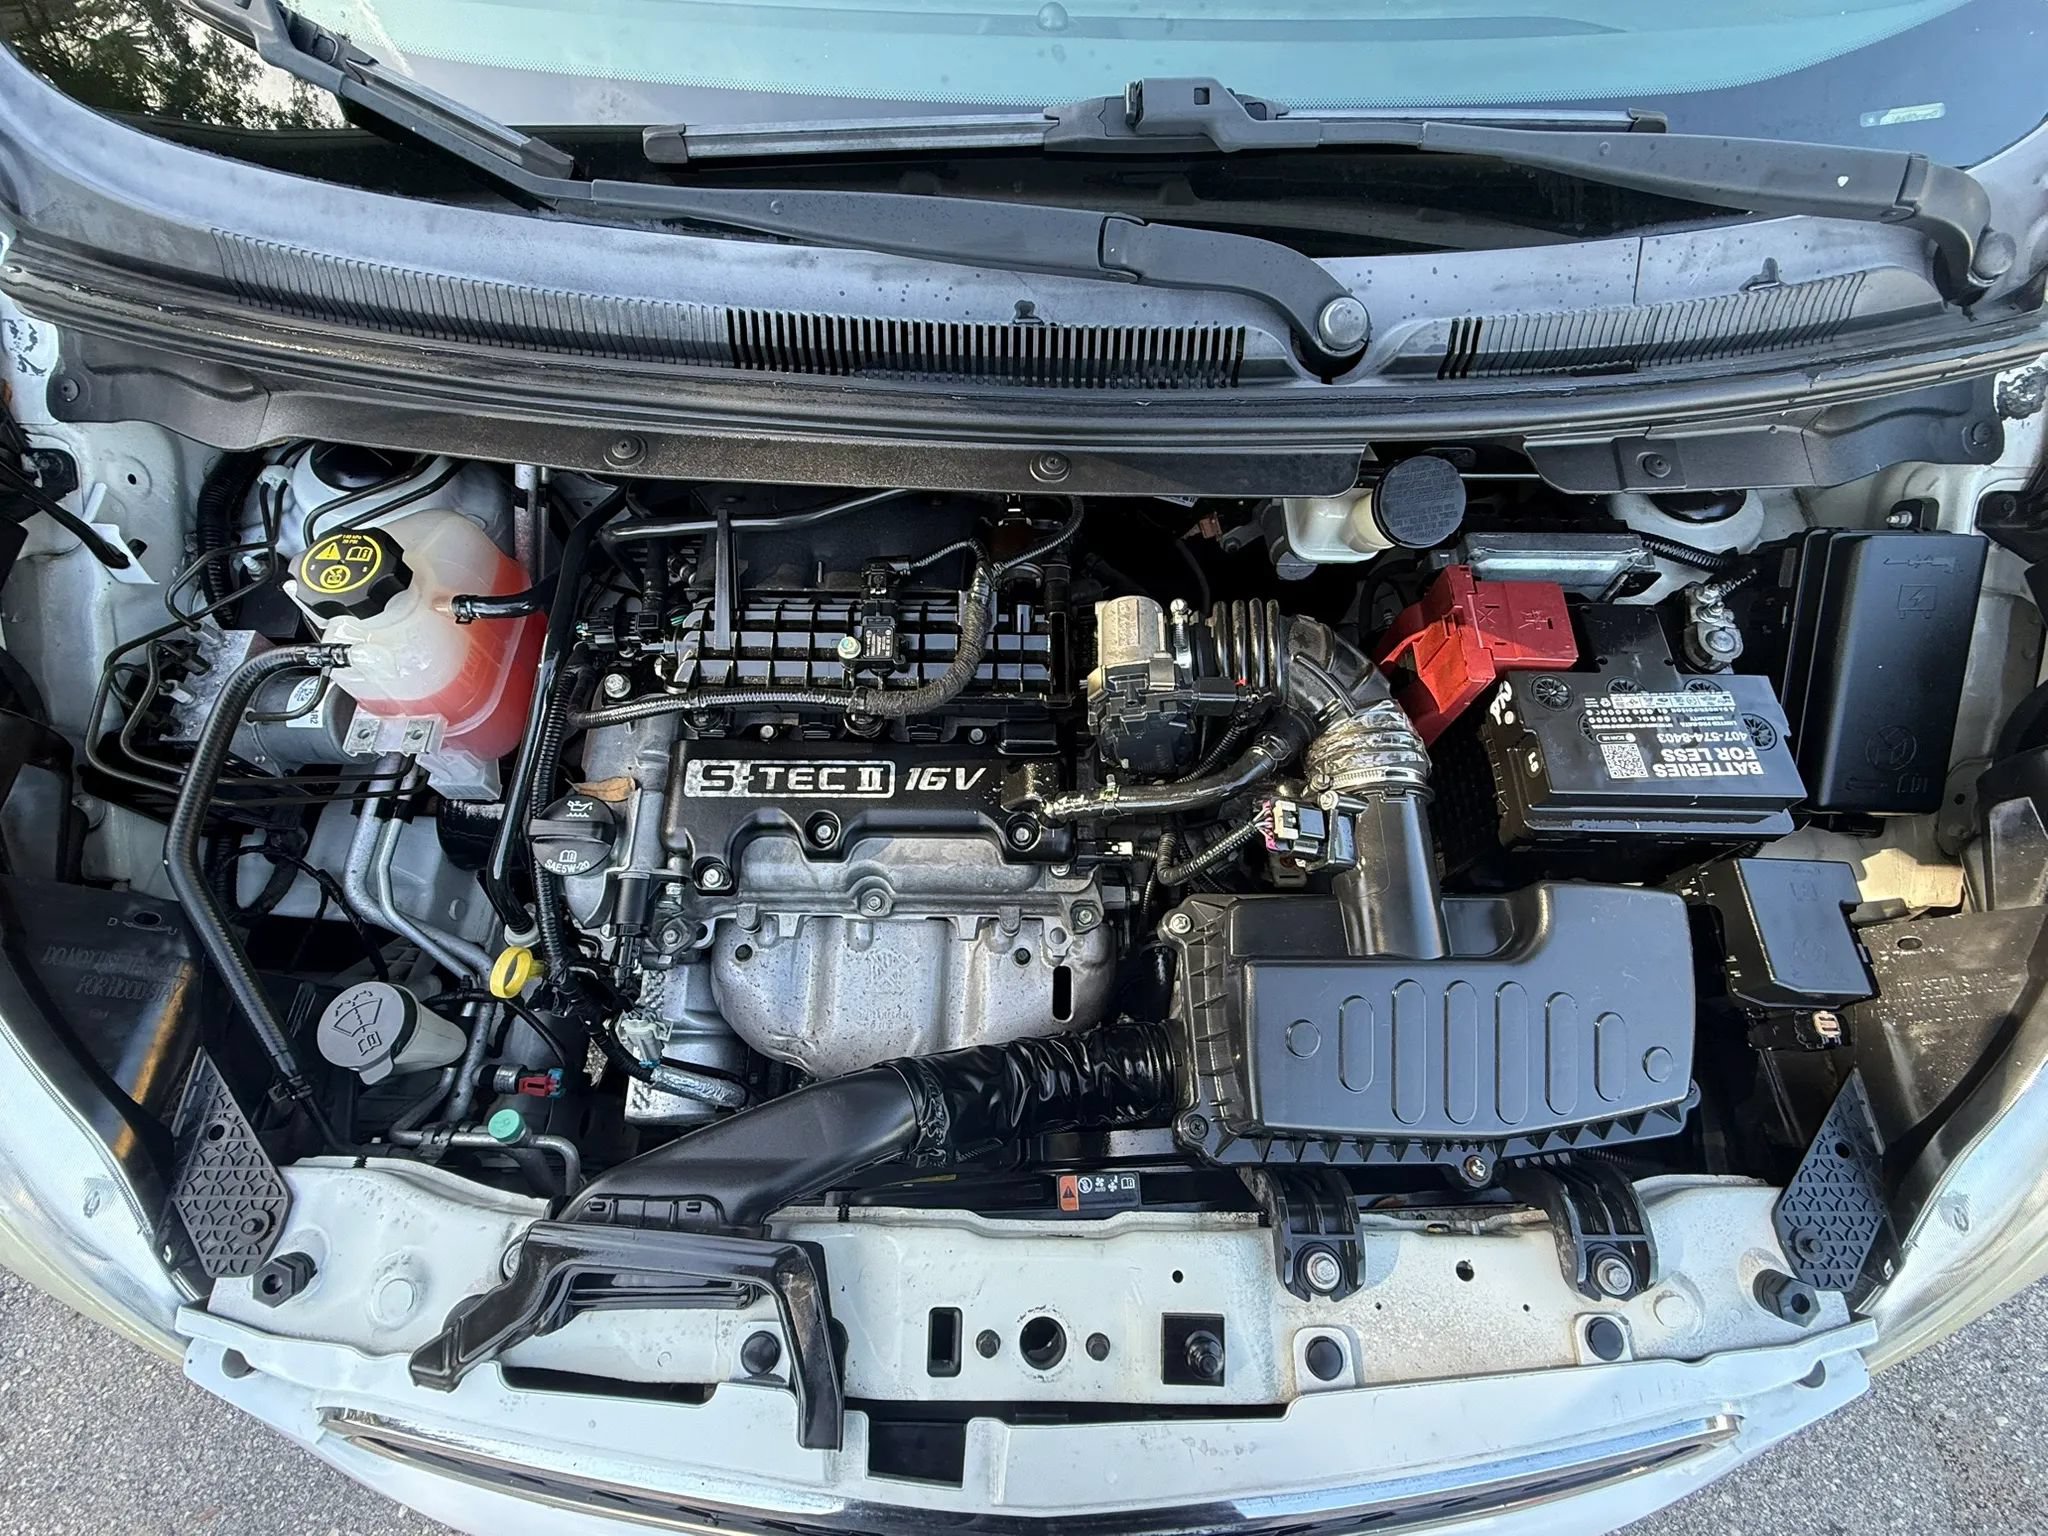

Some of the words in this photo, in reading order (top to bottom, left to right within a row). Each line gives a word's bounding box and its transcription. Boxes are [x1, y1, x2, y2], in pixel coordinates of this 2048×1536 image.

[1657, 732, 1748, 744] 407-574-8403
[1661, 747, 1714, 761] LESS
[1716, 746, 1758, 760] FOR
[1653, 761, 1765, 778] BATTERIES
[905, 767, 987, 792] 16V
